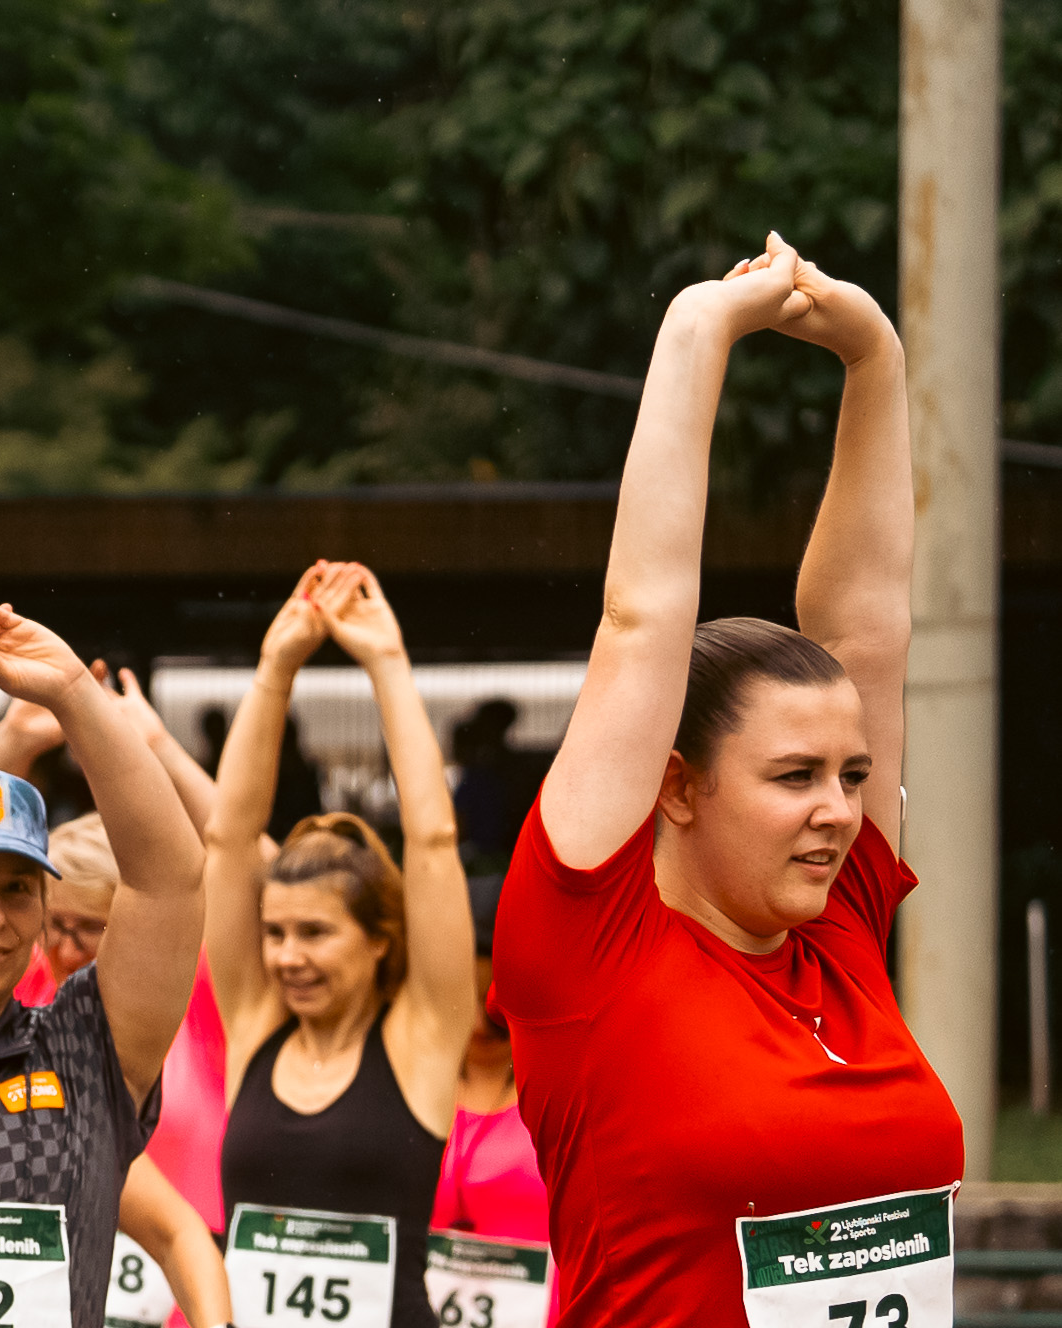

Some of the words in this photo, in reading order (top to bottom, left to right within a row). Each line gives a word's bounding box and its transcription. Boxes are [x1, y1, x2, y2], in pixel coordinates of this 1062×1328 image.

[830, 1222, 849, 1242] 2.
[778, 1252, 825, 1275] Tek
[828, 1233, 931, 1269] zaposlenih
[262, 1271, 351, 1321] 145
